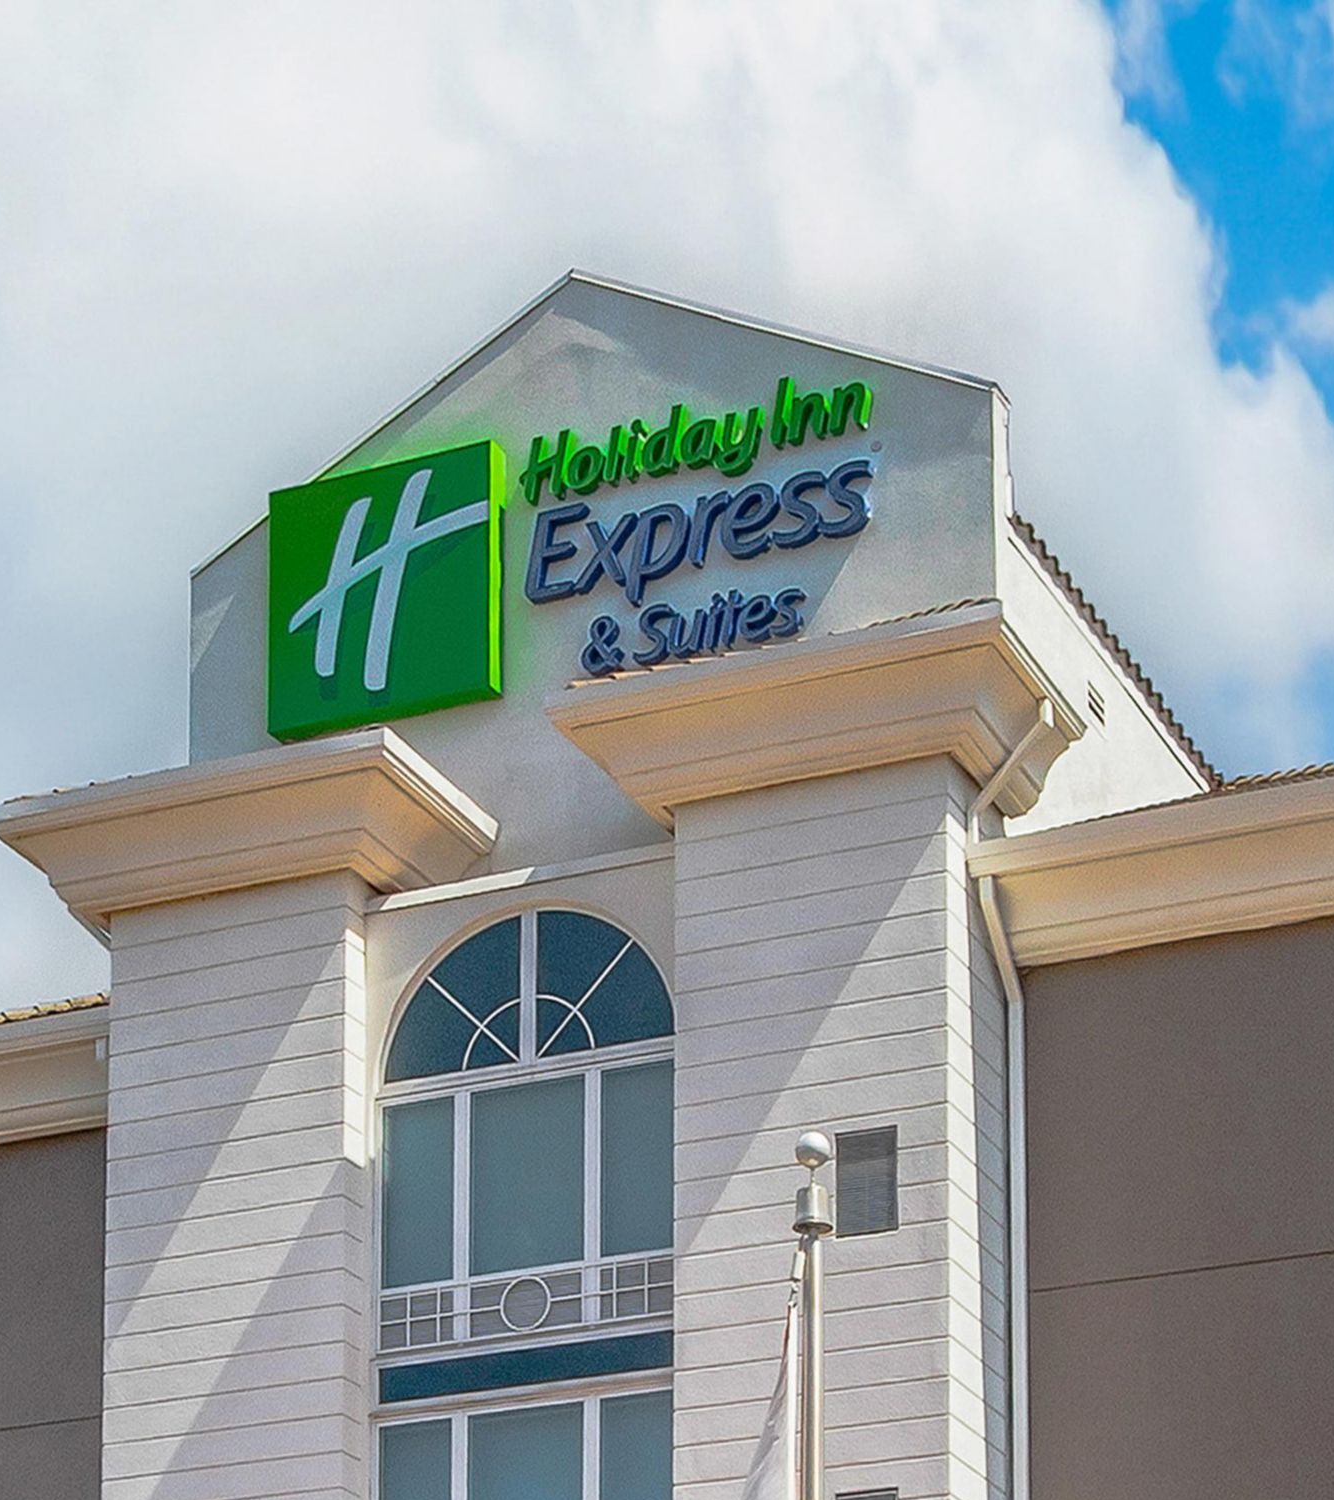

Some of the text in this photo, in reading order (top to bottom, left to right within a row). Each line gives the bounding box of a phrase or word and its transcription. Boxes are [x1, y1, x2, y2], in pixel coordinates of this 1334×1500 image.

[519, 375, 872, 506] Holiday Inn
[524, 457, 875, 608] Express
[579, 586, 808, 677] & Suites
